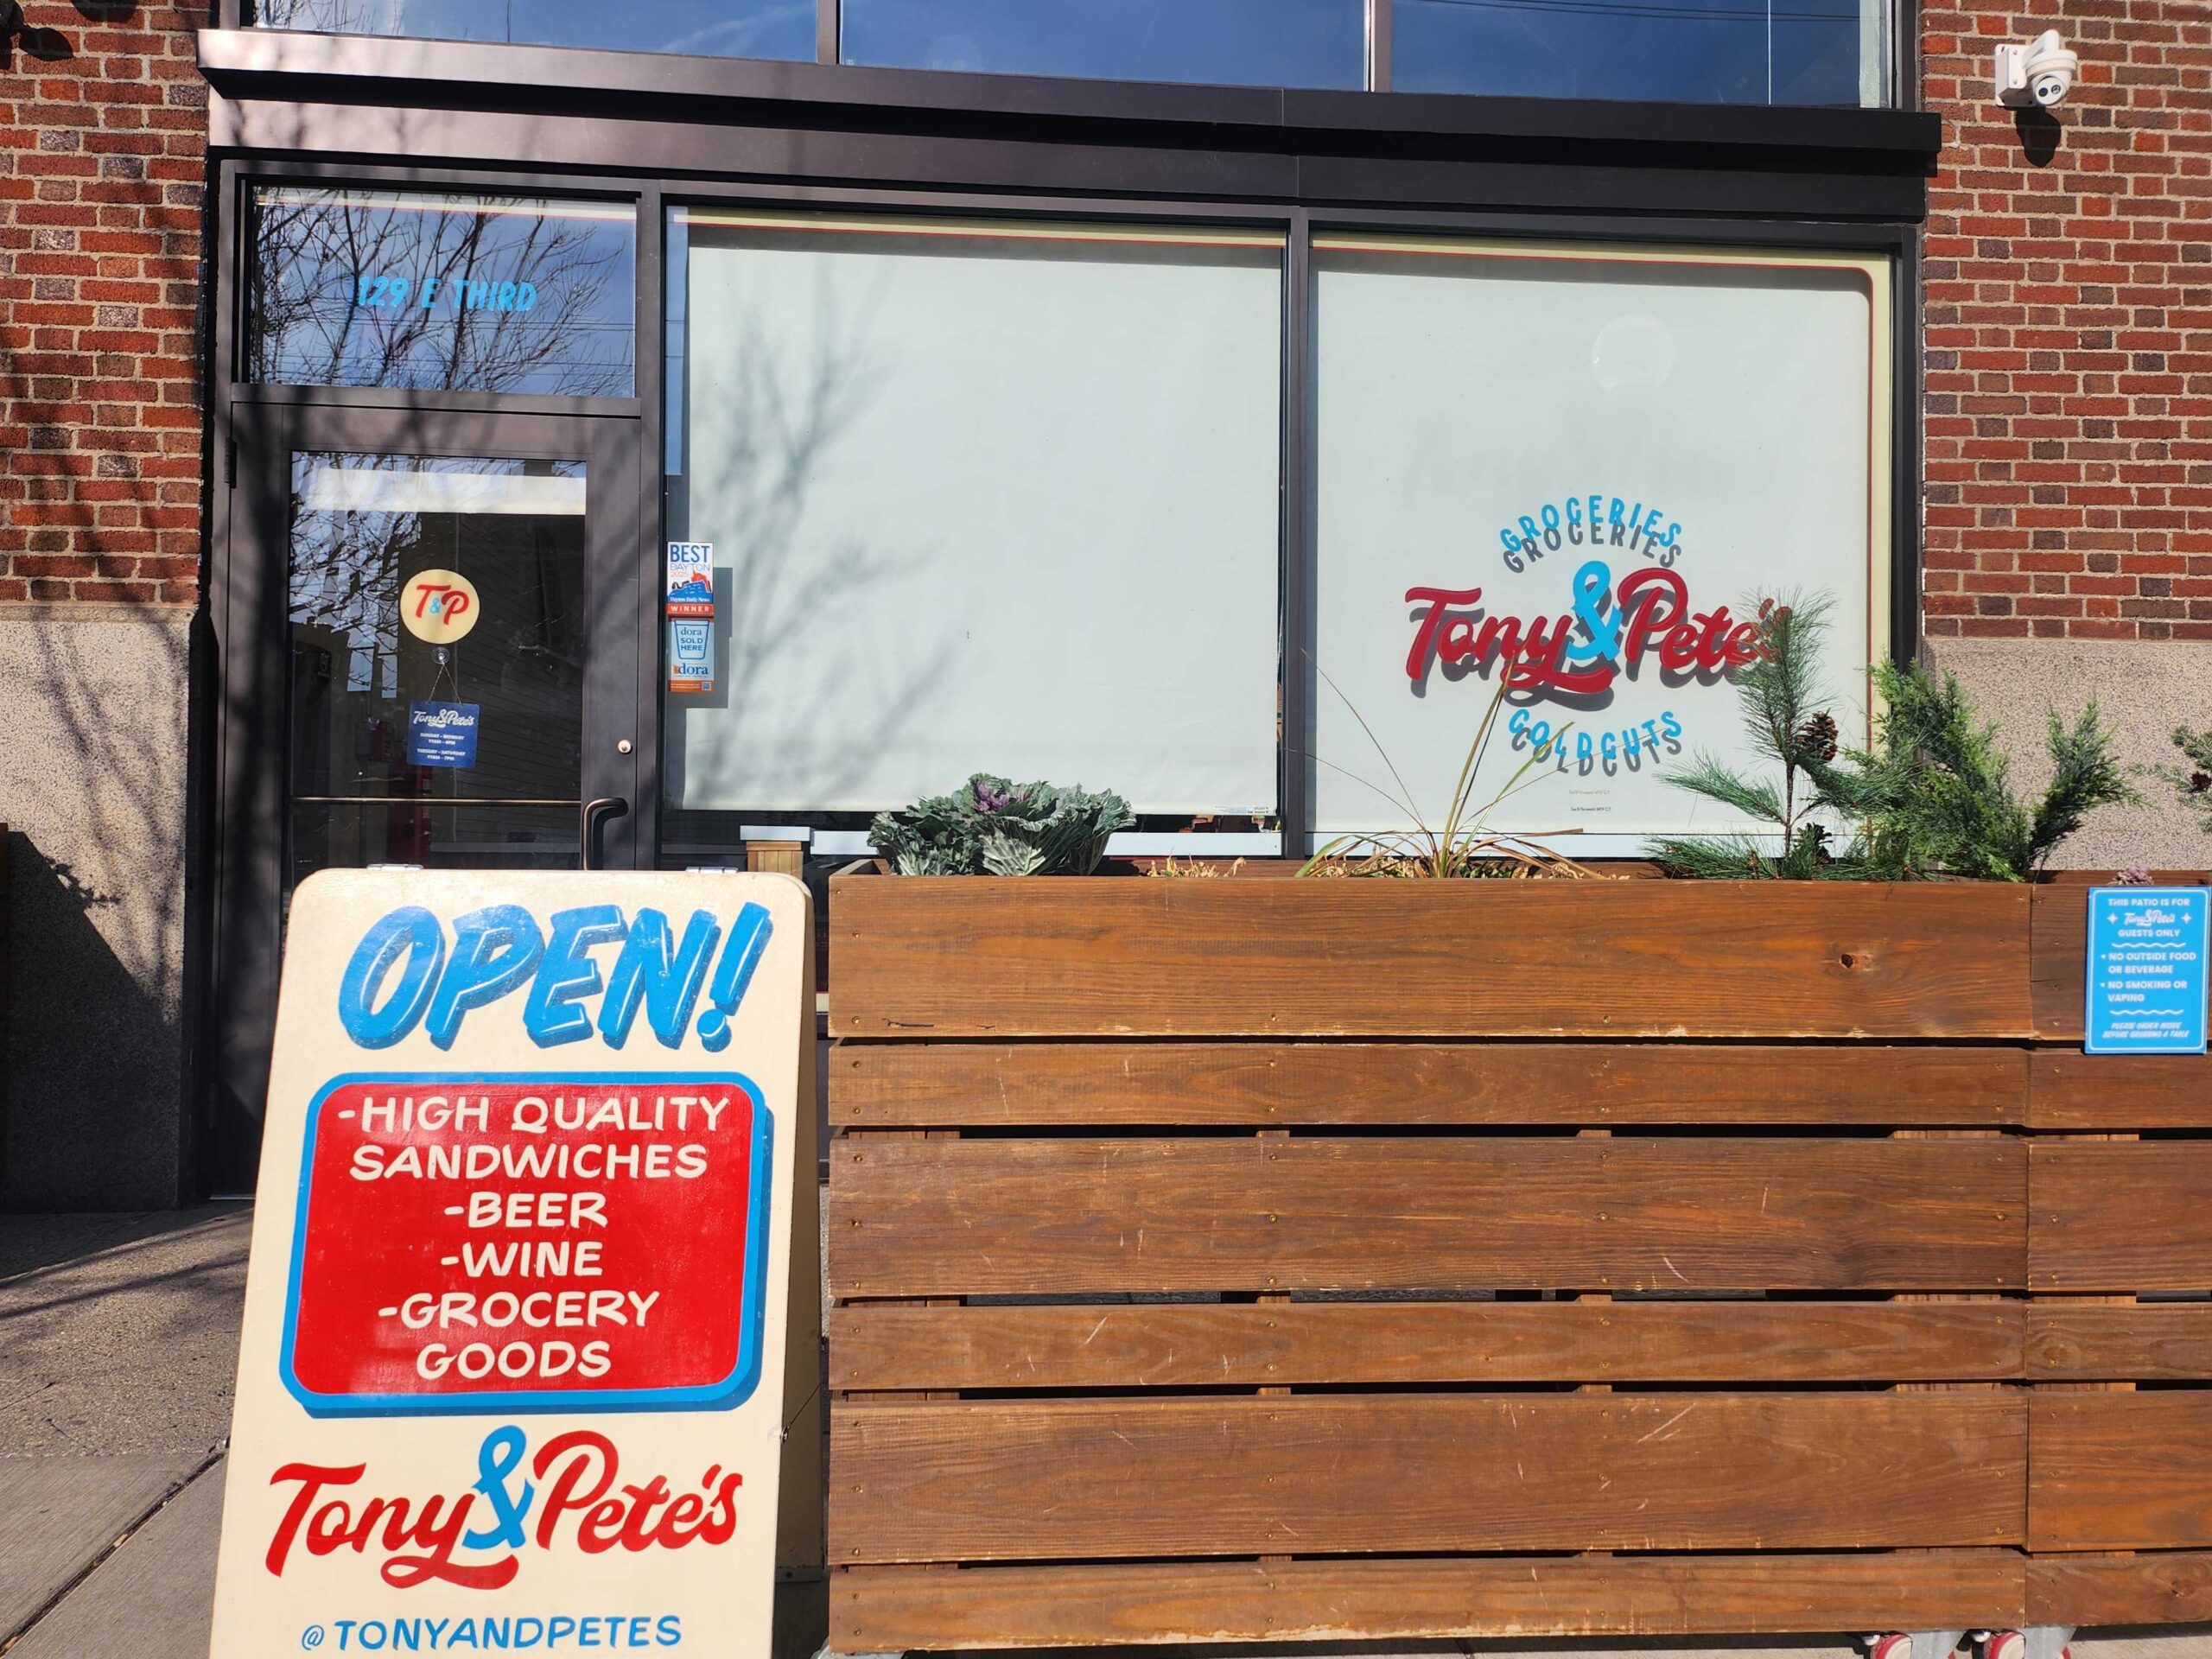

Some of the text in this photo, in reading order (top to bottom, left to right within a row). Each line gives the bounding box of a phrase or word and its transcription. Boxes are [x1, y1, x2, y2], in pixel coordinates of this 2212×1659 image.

[359, 276, 537, 311] 129 E THIRD
[1499, 495, 1681, 553] GROCERIES
[670, 544, 710, 563] BEST
[680, 627, 702, 636] dora
[678, 663, 709, 675] dora
[1508, 709, 1681, 760] COLDCUTS
[2118, 929, 2180, 938] GUESTS ONLY
[338, 901, 774, 1052] OPEN!
[2107, 965, 2173, 974] OR BEVERAGE
[2107, 981, 2187, 989] NO SMOKING OR
[2107, 994, 2145, 1002] VAPING
[511, 1096, 730, 1135] QUALITY
[349, 1143, 708, 1181] SANDWICHES
[415, 1341, 612, 1380] GOODS
